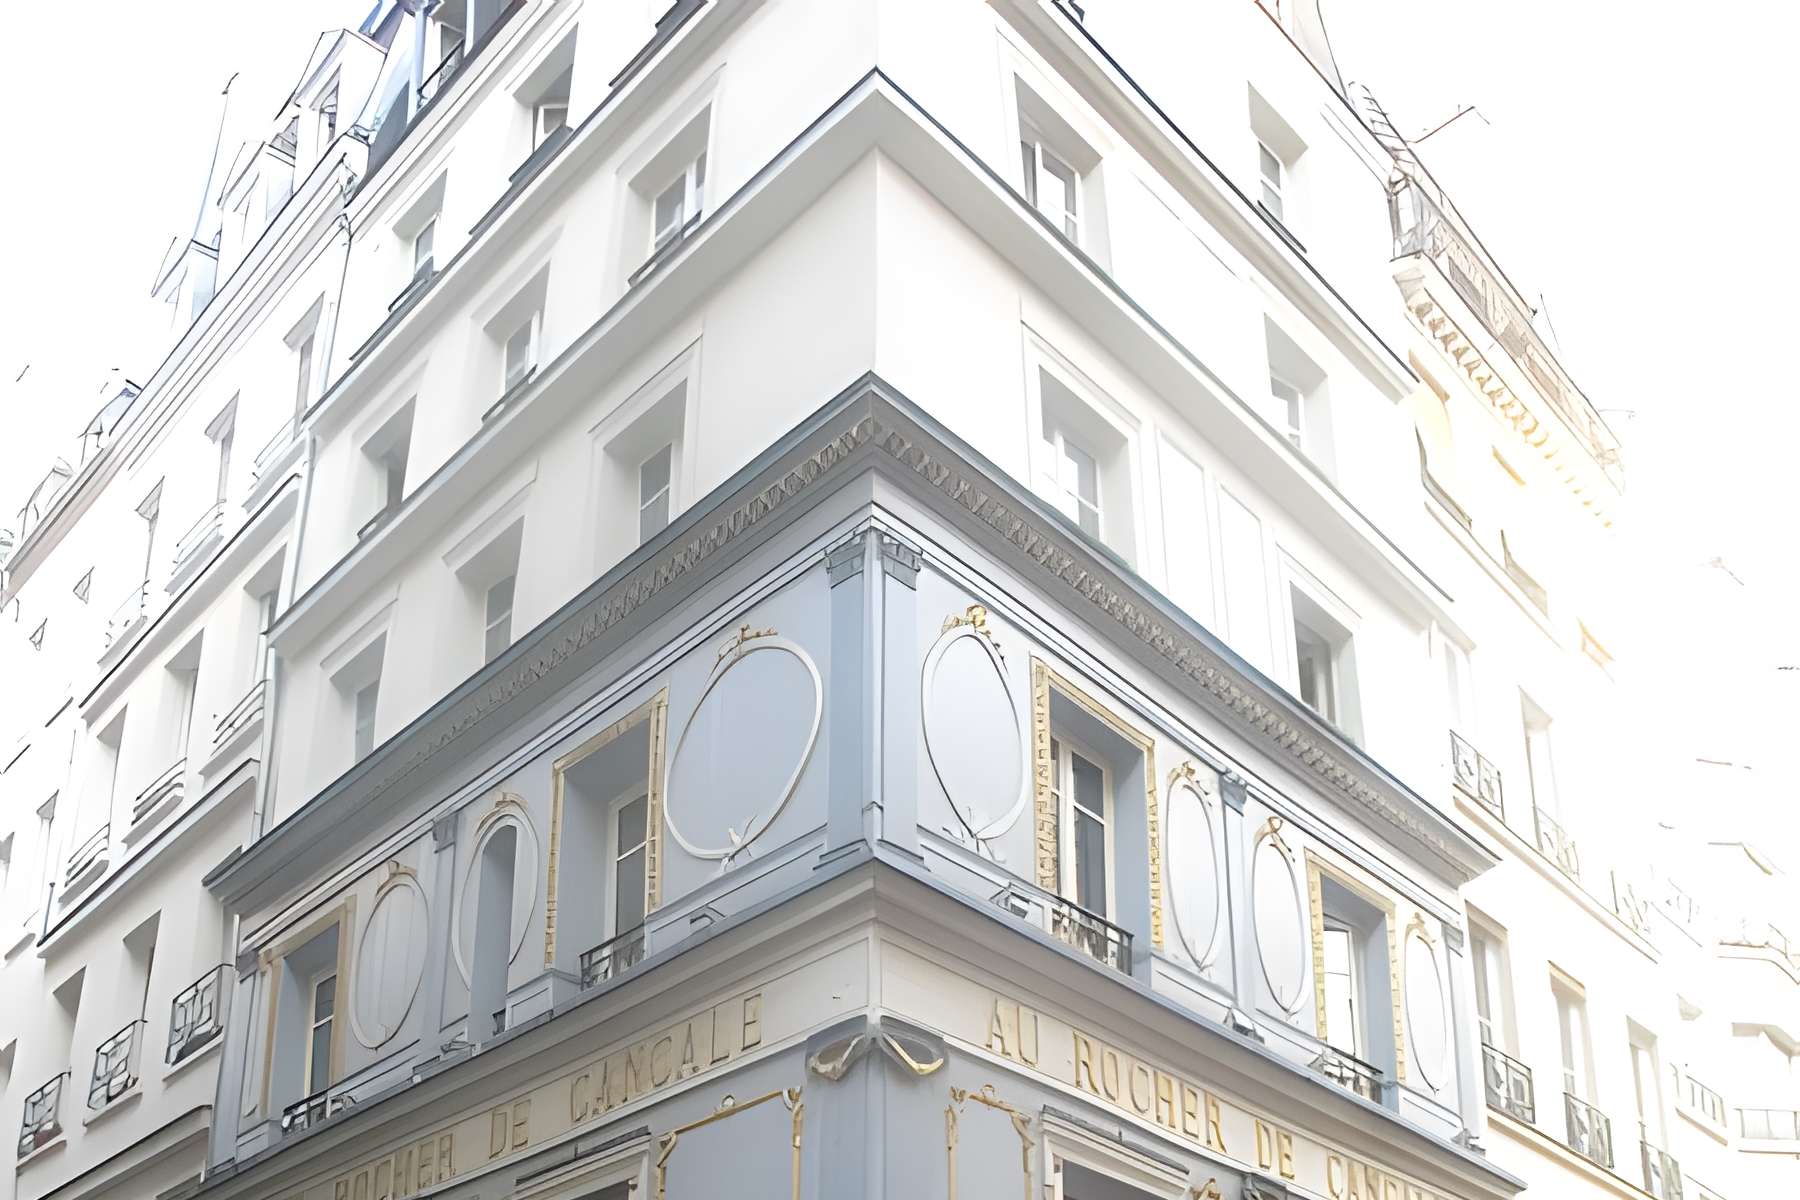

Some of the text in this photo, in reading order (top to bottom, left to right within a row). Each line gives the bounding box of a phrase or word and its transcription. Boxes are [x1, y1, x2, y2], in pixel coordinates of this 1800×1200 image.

[489, 1099, 532, 1160] DE
[570, 993, 766, 1123] CANCALE
[985, 997, 1040, 1067] AU
[1072, 1029, 1229, 1156] ROCHER
[1254, 1117, 1296, 1180] DE
